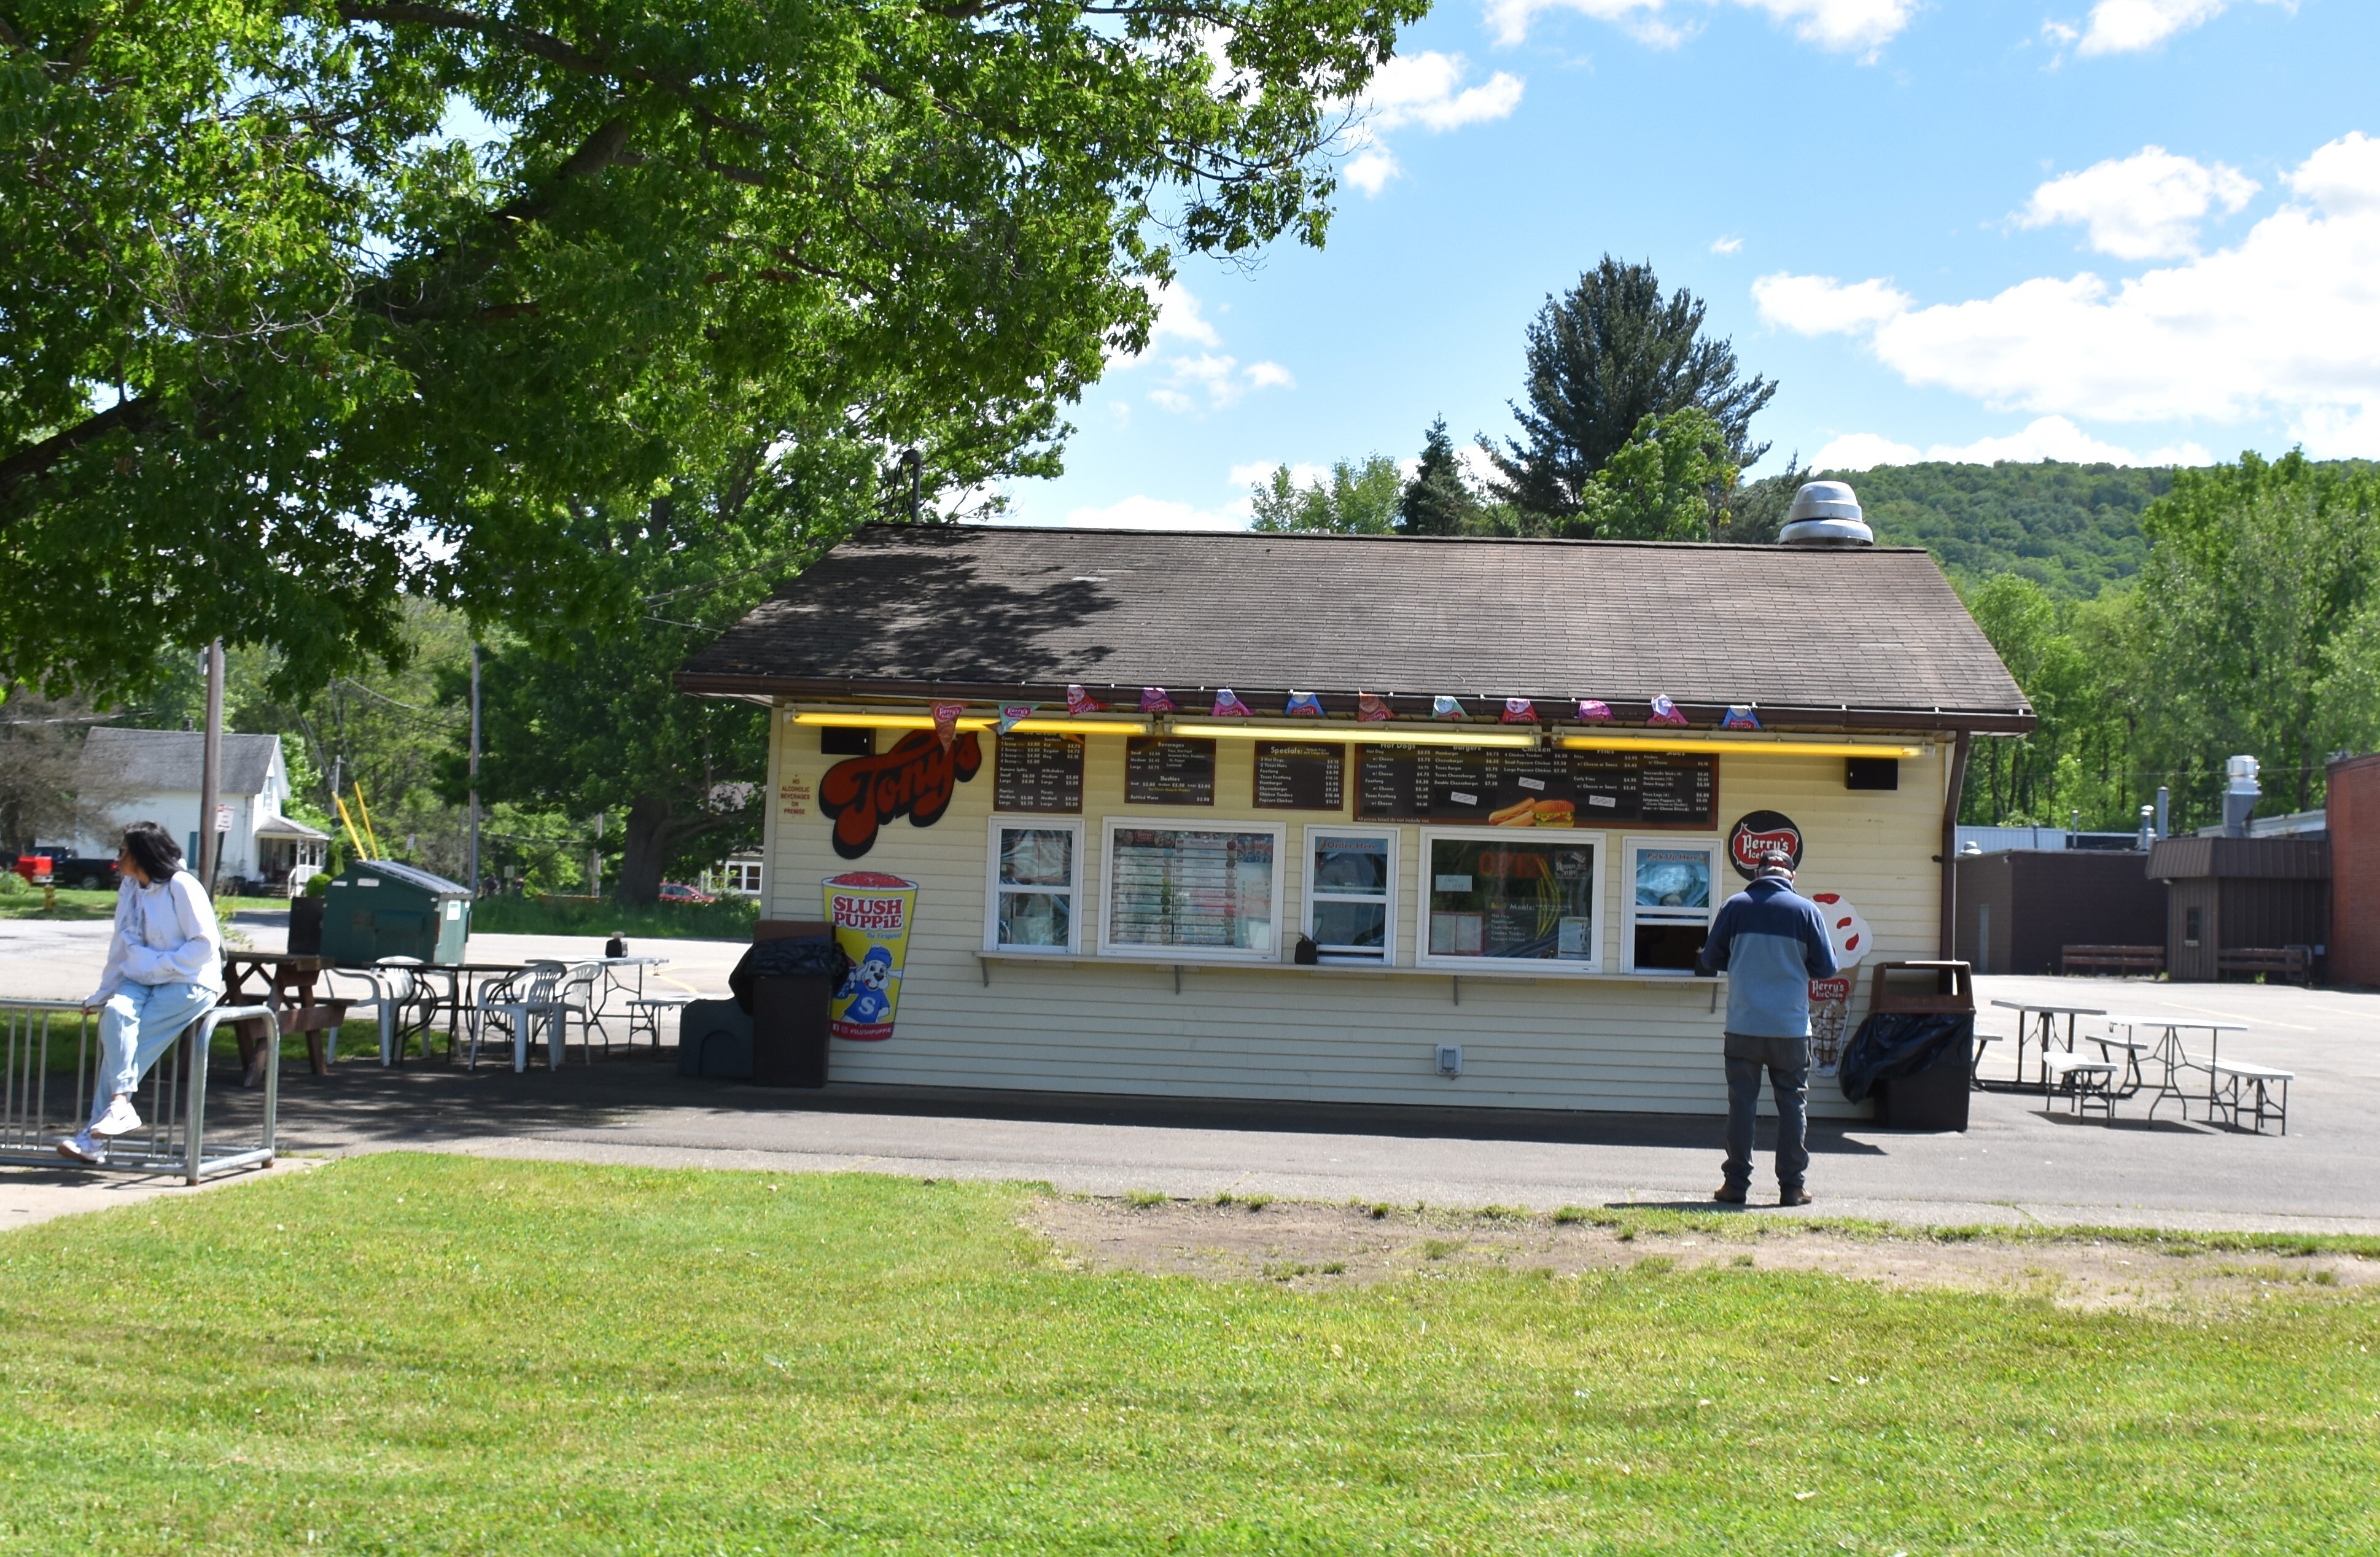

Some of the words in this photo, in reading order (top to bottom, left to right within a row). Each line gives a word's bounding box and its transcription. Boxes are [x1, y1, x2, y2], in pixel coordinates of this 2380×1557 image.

[1742, 835, 1789, 855] Perry's
[1748, 849, 1759, 859] Ice
[833, 896, 902, 915] SLUSH
[1811, 980, 1844, 994] Perry's
[858, 997, 876, 1014] S
